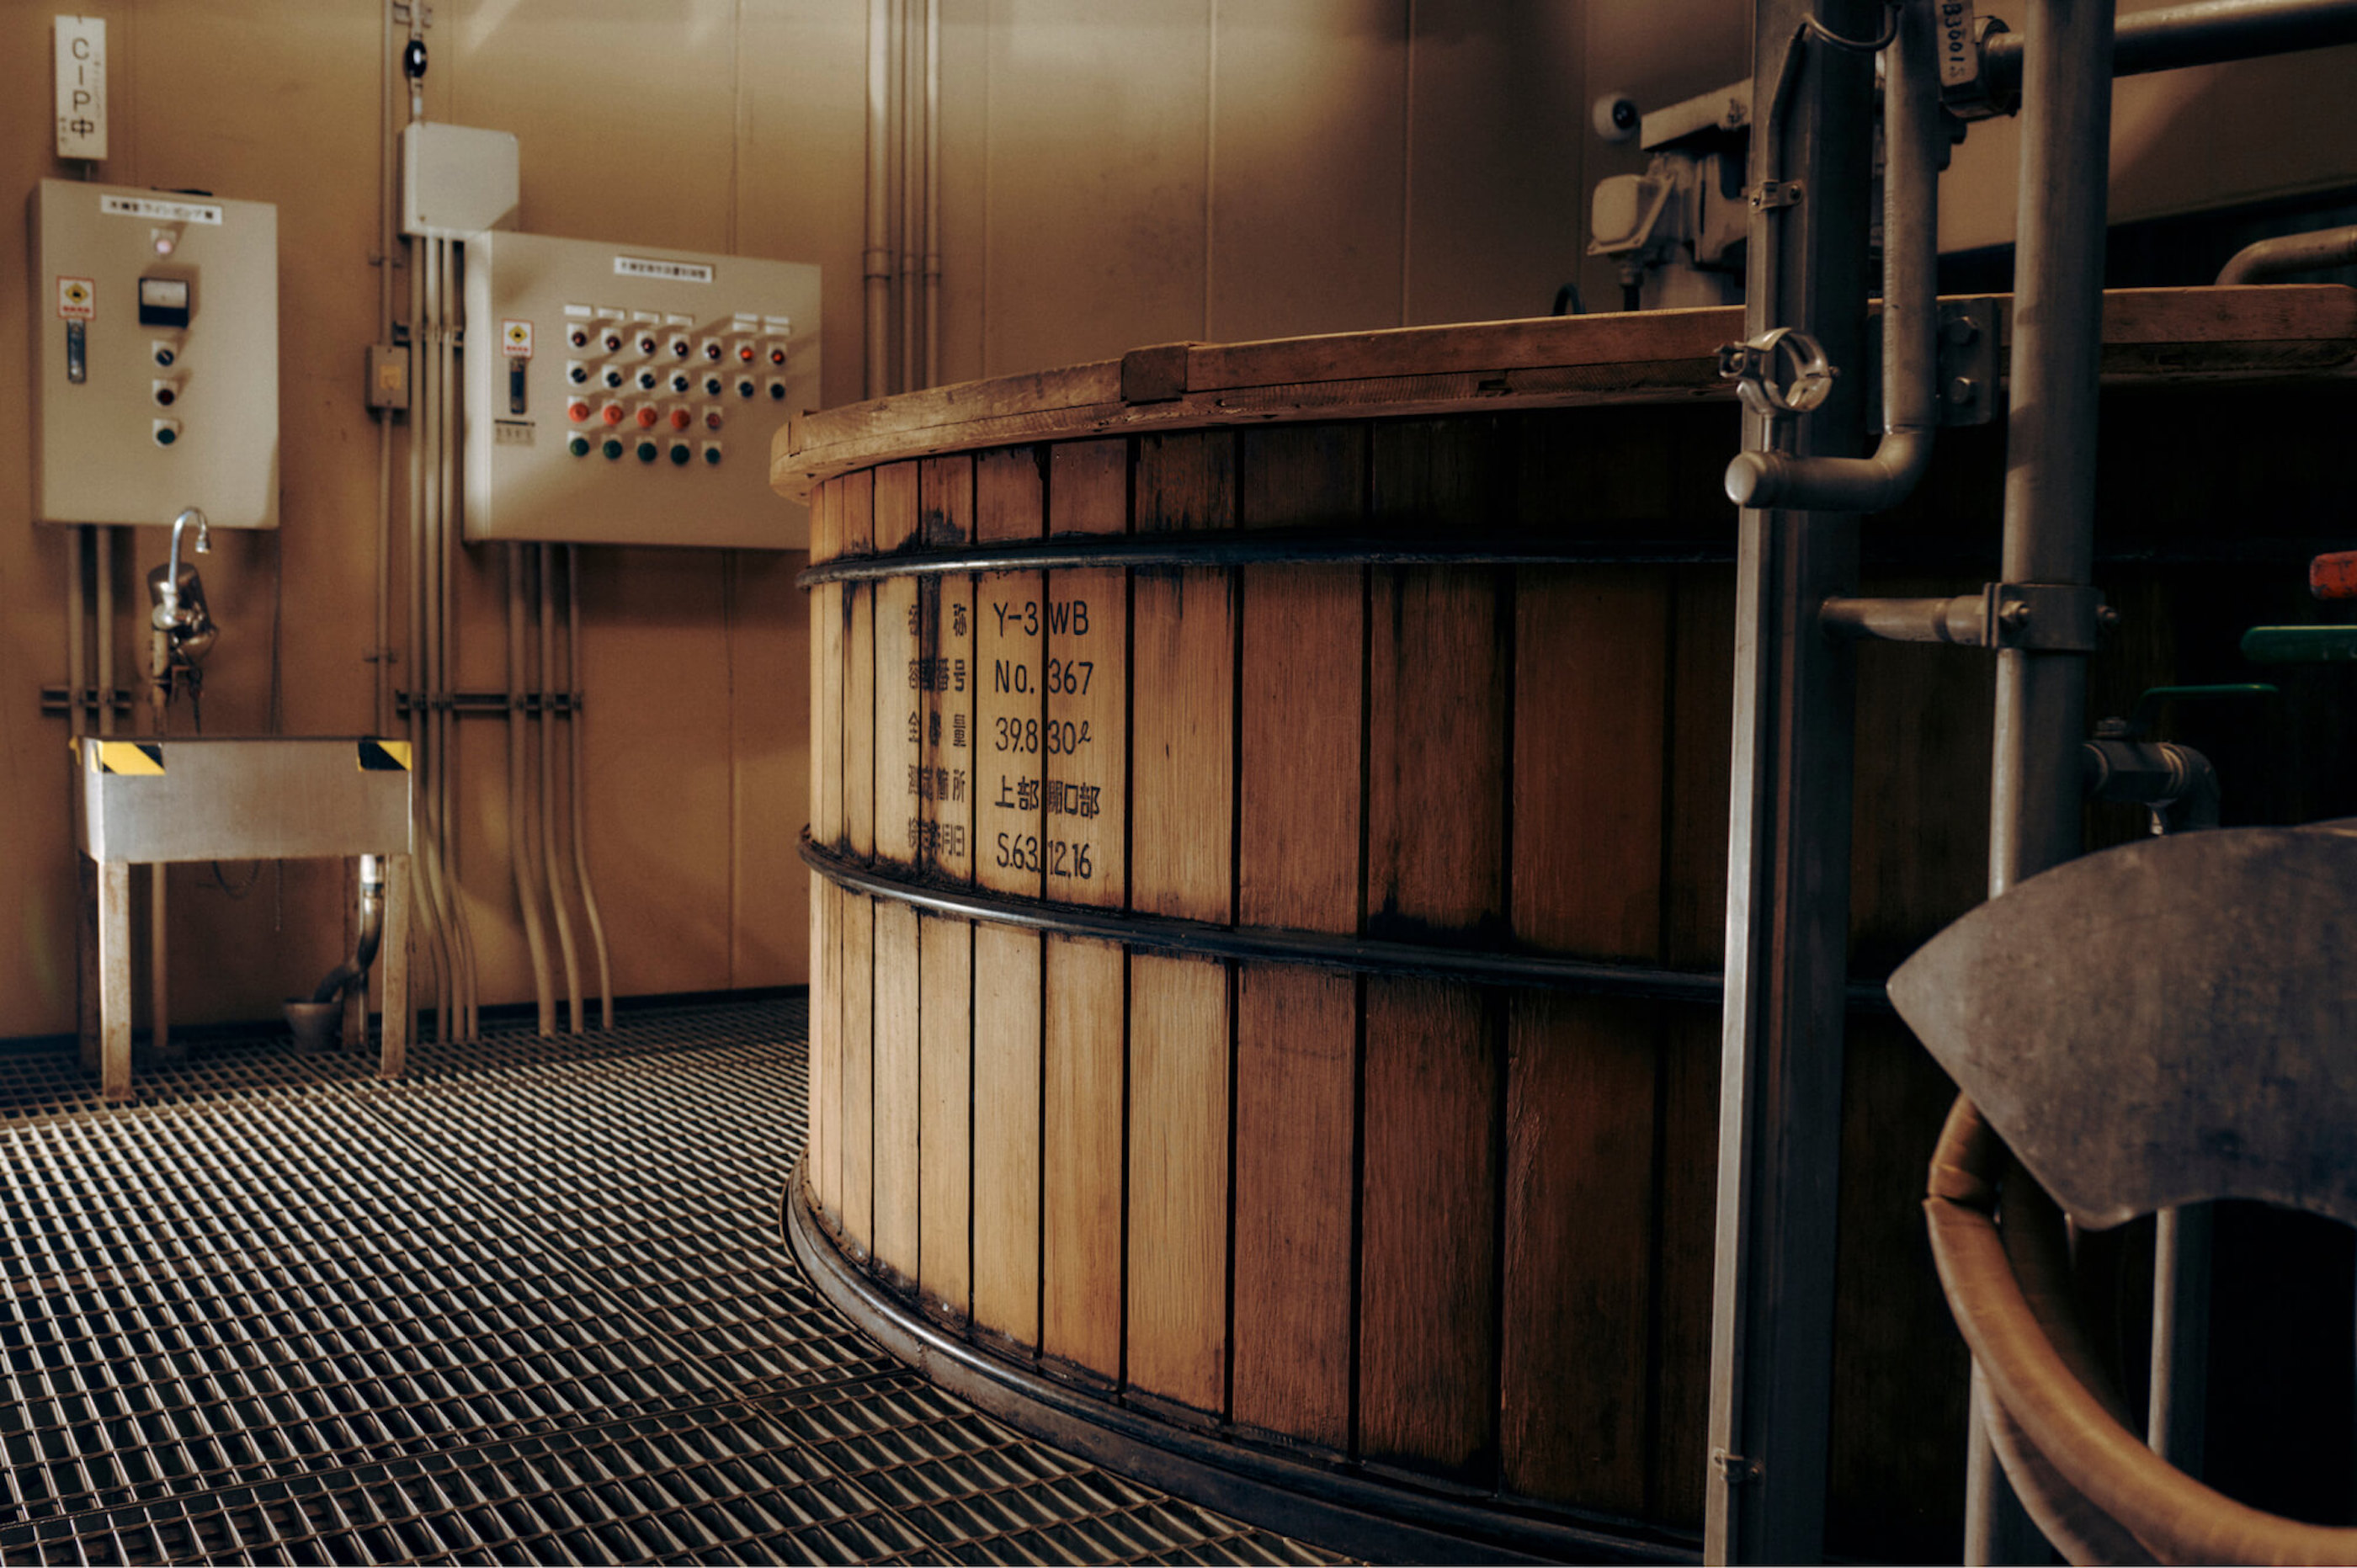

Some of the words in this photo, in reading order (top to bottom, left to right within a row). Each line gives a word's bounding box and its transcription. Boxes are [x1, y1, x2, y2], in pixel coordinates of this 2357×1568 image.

[70, 37, 94, 139] CIP中
[994, 774, 1102, 820] 上部開口部
